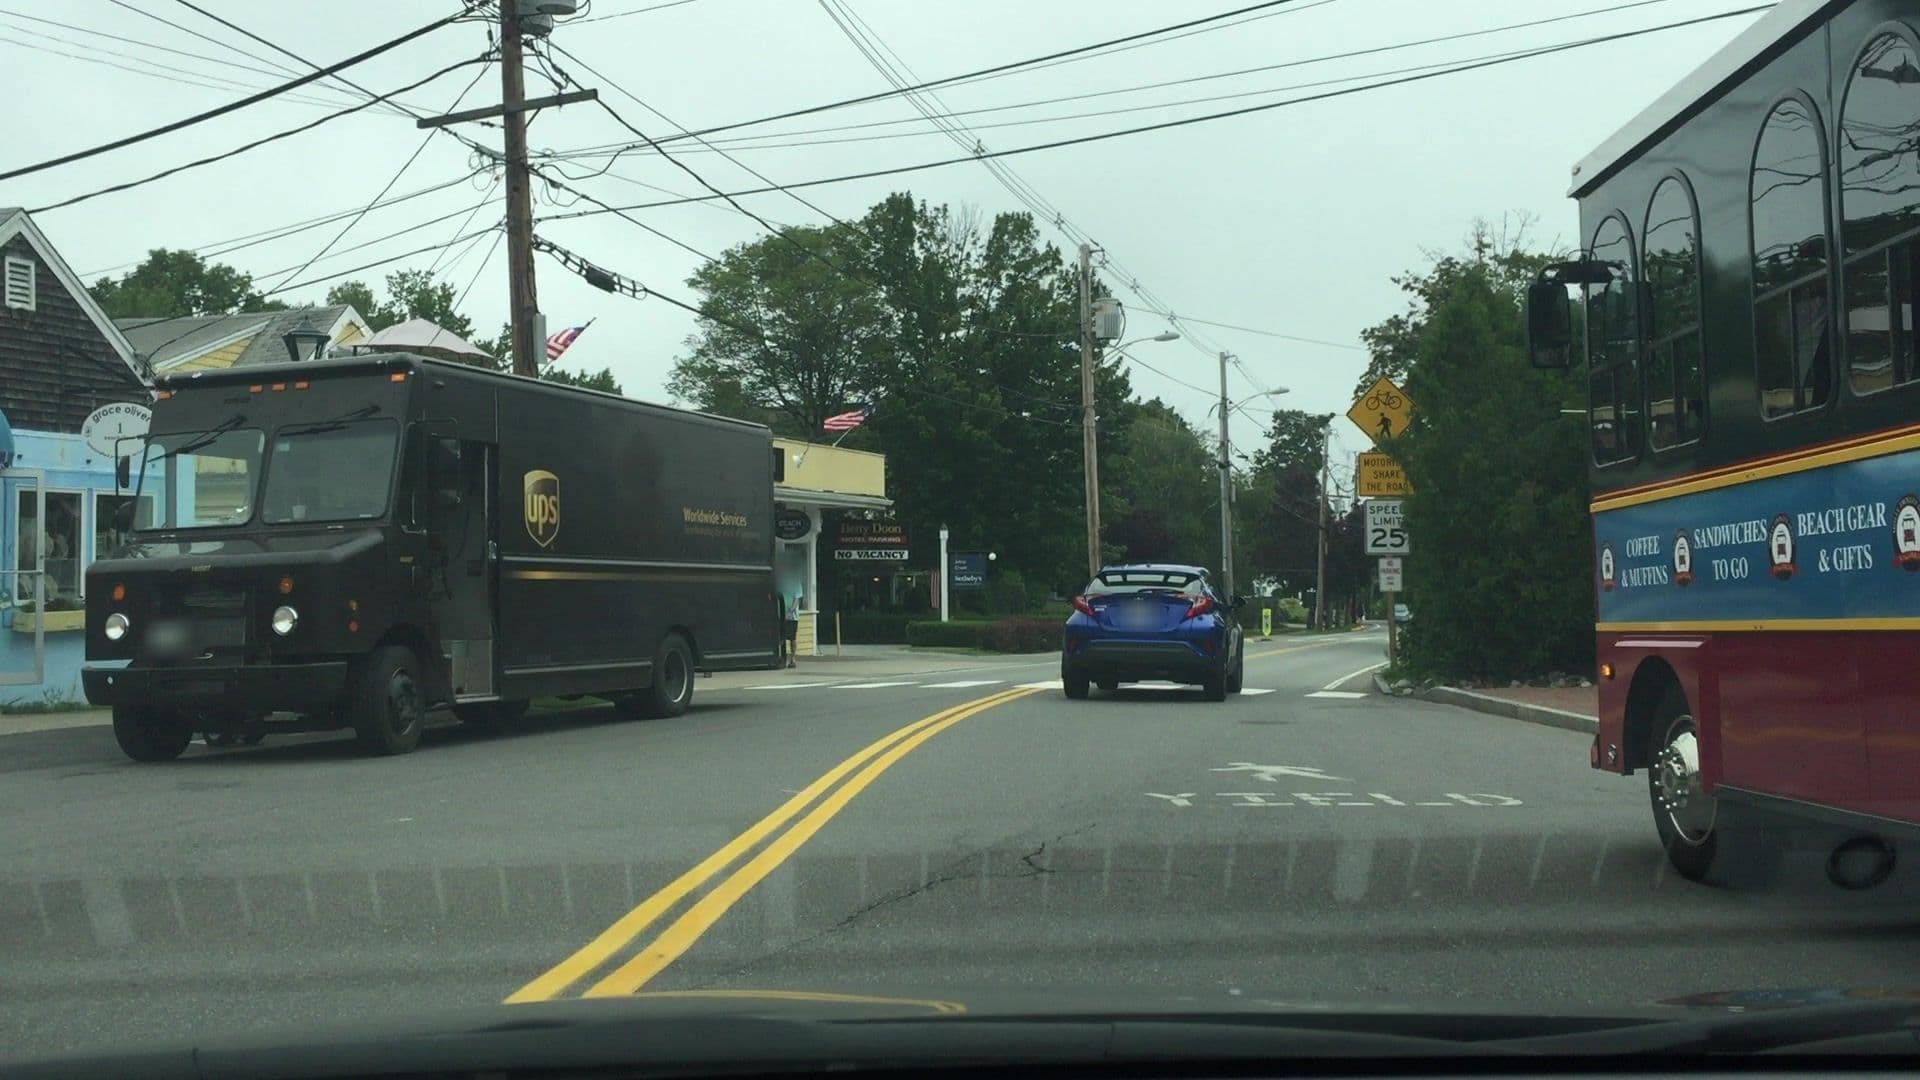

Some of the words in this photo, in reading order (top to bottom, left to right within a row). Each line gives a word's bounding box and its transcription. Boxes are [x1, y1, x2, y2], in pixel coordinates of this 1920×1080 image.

[92, 406, 121, 424] grace
[1373, 470, 1400, 479] SHARE
[1366, 482, 1382, 491] THE
[1386, 482, 1409, 491] ROAD
[527, 493, 557, 536] ups
[683, 507, 720, 525] Worldwide
[720, 511, 747, 527] Services
[1369, 505, 1402, 515] SPEE
[1797, 508, 1846, 537] BEACH
[1847, 502, 1887, 530] GEAR
[1373, 516, 1402, 526] LIMIT
[1371, 528, 1405, 548] 25
[1693, 519, 1768, 549] SANDWICHES
[1626, 536, 1660, 558] COFFEE
[1712, 559, 1729, 581] TO
[1731, 557, 1749, 579] GO
[1818, 549, 1830, 573] &
[1833, 545, 1873, 571] GIFTS
[1621, 572, 1629, 588] &
[1629, 566, 1669, 587] MUFFINS
[1143, 791, 1524, 806] YIELD
